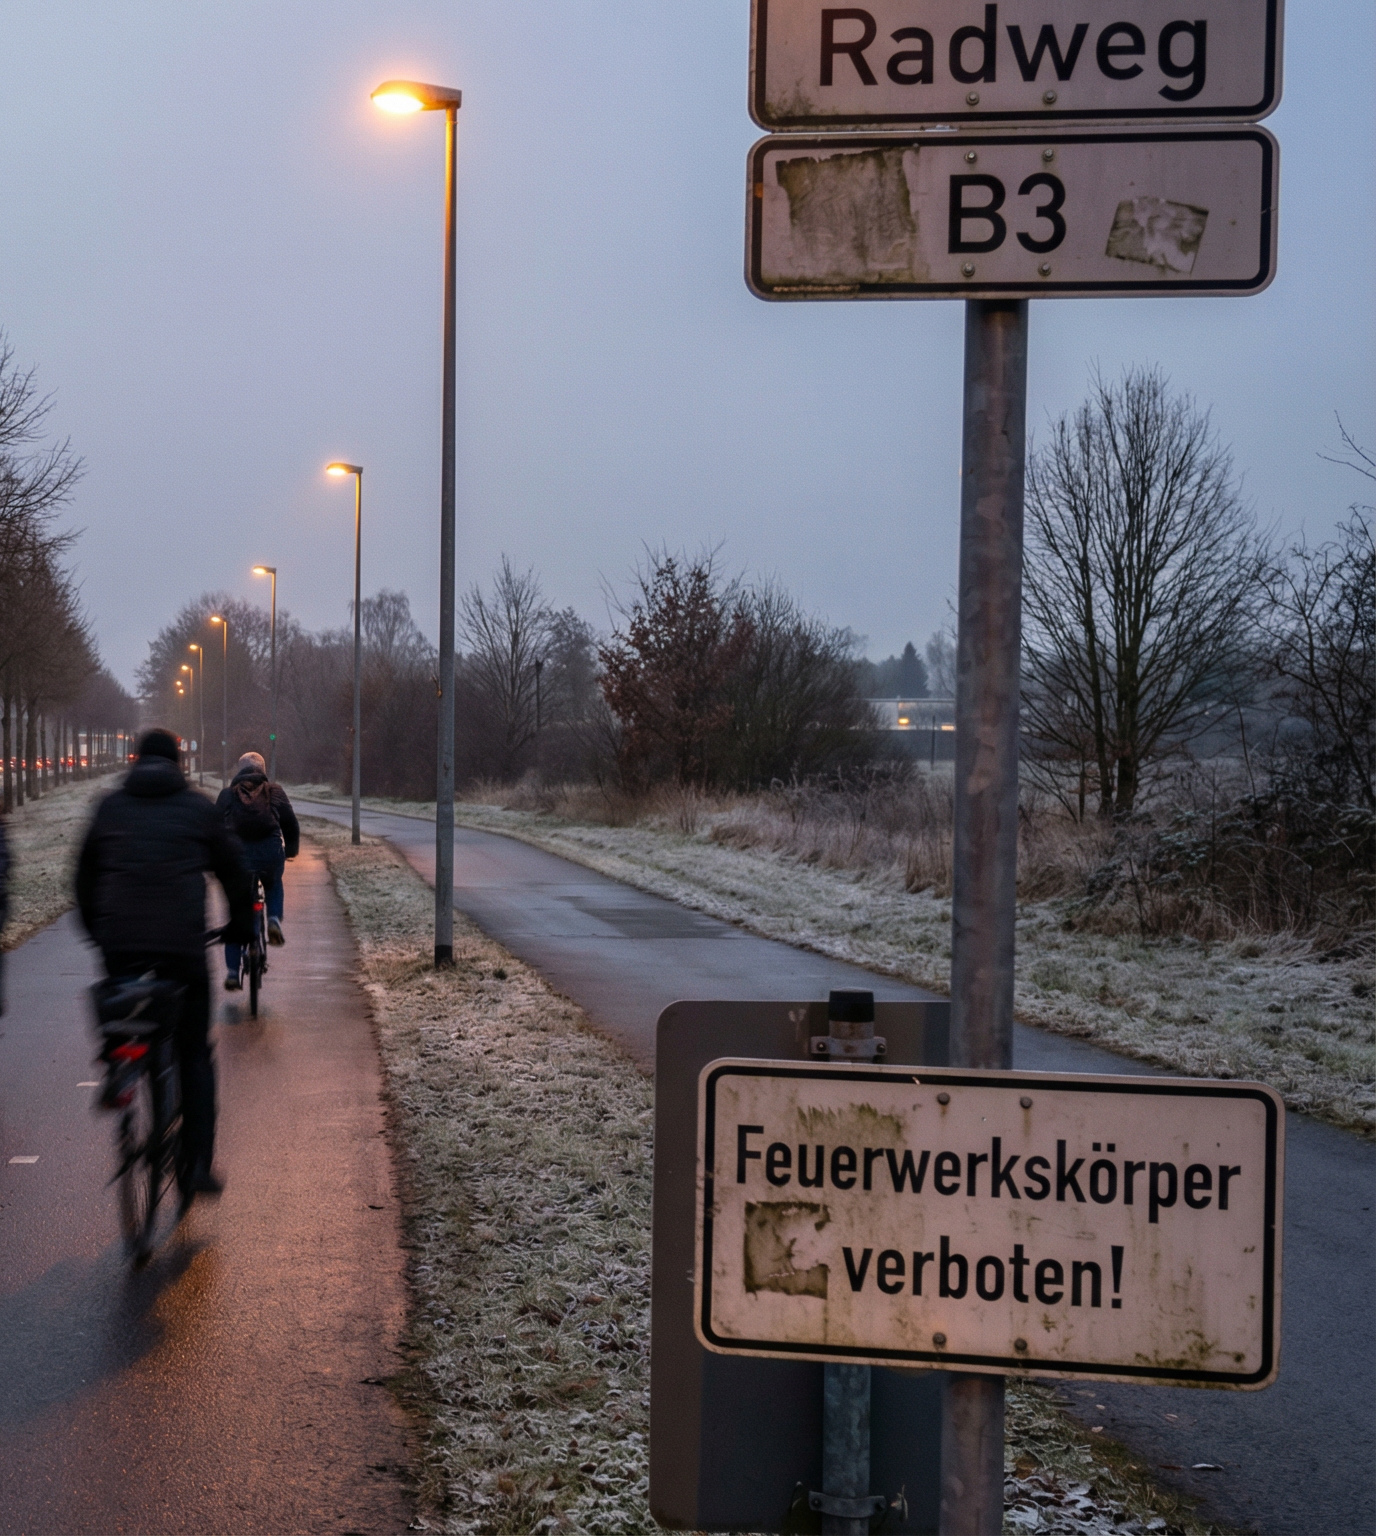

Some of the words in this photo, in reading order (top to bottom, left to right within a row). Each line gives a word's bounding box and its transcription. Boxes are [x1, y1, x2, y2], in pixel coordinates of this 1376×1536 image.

[819, 3, 1208, 102] Radweg
[947, 172, 1067, 254] B3
[736, 1124, 1242, 1224] Feuerwerkskörper
[841, 1235, 1125, 1309] verboten!
